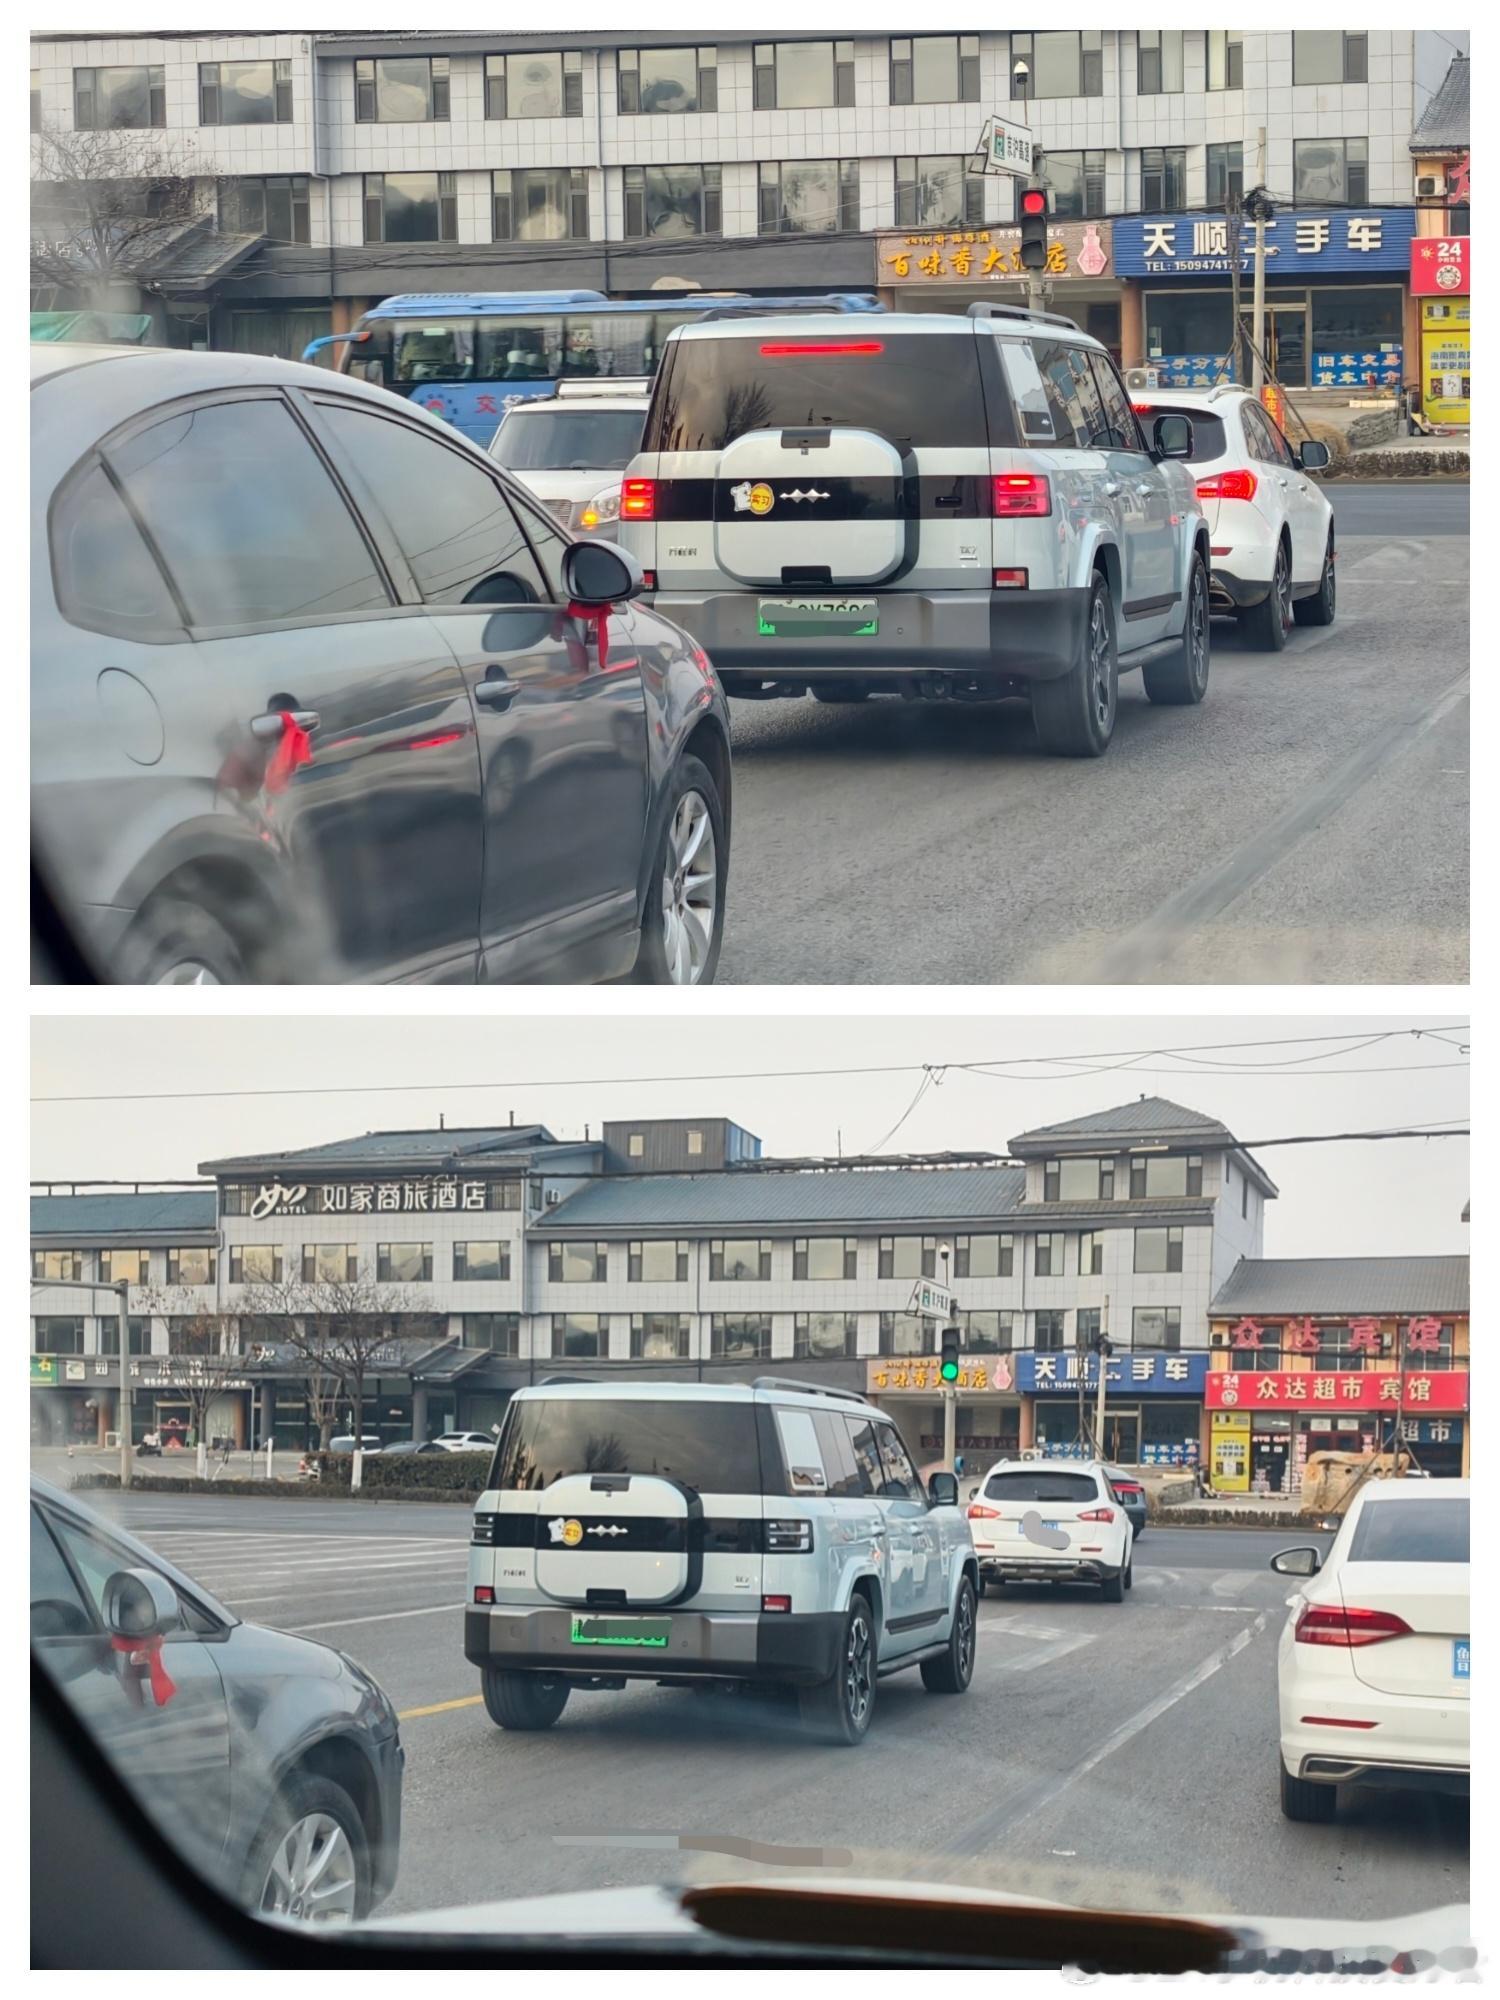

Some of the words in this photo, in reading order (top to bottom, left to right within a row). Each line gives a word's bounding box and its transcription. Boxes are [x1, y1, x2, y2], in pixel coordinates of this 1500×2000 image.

[1142, 218, 1383, 257] 天顺二手车
[1437, 242, 1462, 257] 24
[1145, 261, 1172, 272] TEL:
[322, 1181, 486, 1211] 如家商旅酒店
[275, 1205, 307, 1215] HOTEL
[1232, 1317, 1443, 1353] 众达宾馆
[1222, 1374, 1239, 1385] 24
[1256, 1376, 1364, 1400] 众达超市
[1379, 1376, 1432, 1401] 宾馆
[1401, 1420, 1452, 1442] 超市
